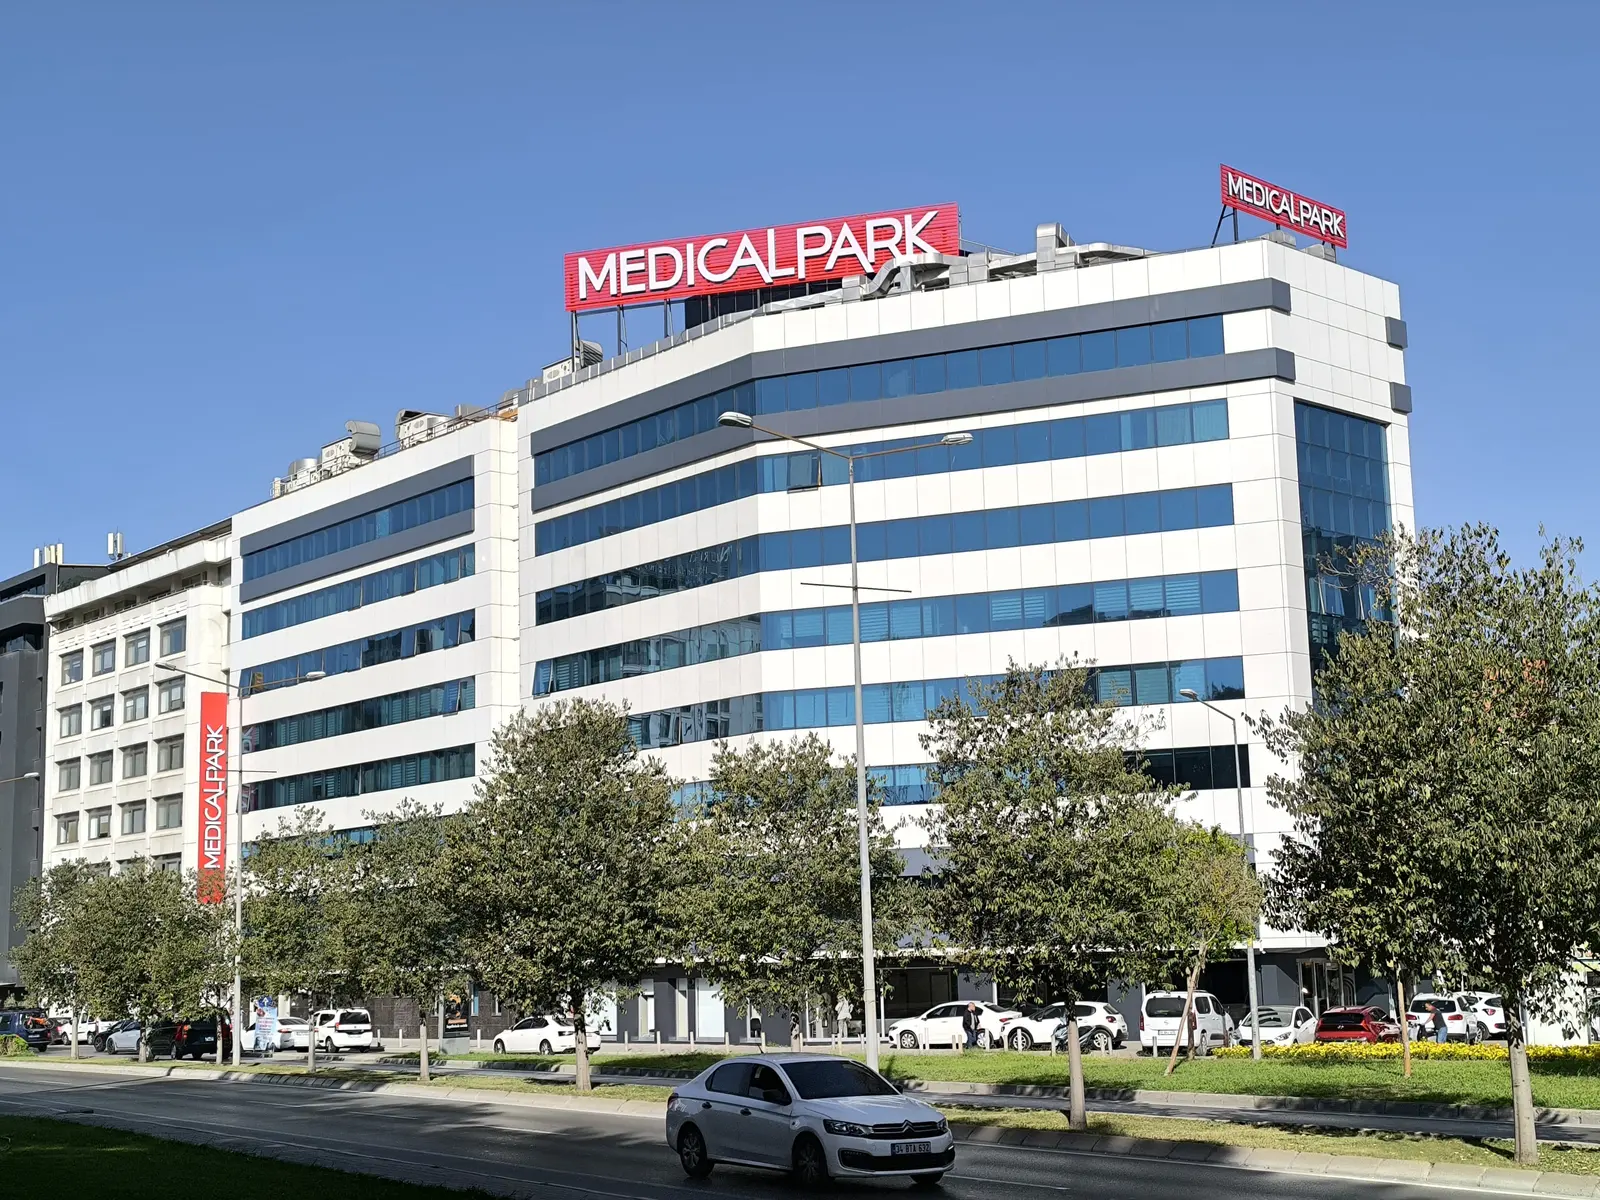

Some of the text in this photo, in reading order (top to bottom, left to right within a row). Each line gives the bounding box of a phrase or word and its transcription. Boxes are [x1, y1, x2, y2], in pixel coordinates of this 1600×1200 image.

[1227, 171, 1345, 238] MEDICALPARK
[577, 210, 939, 300] MEDICALPARK
[203, 724, 226, 869] MEDICALPARK
[895, 1144, 903, 1153] 34
